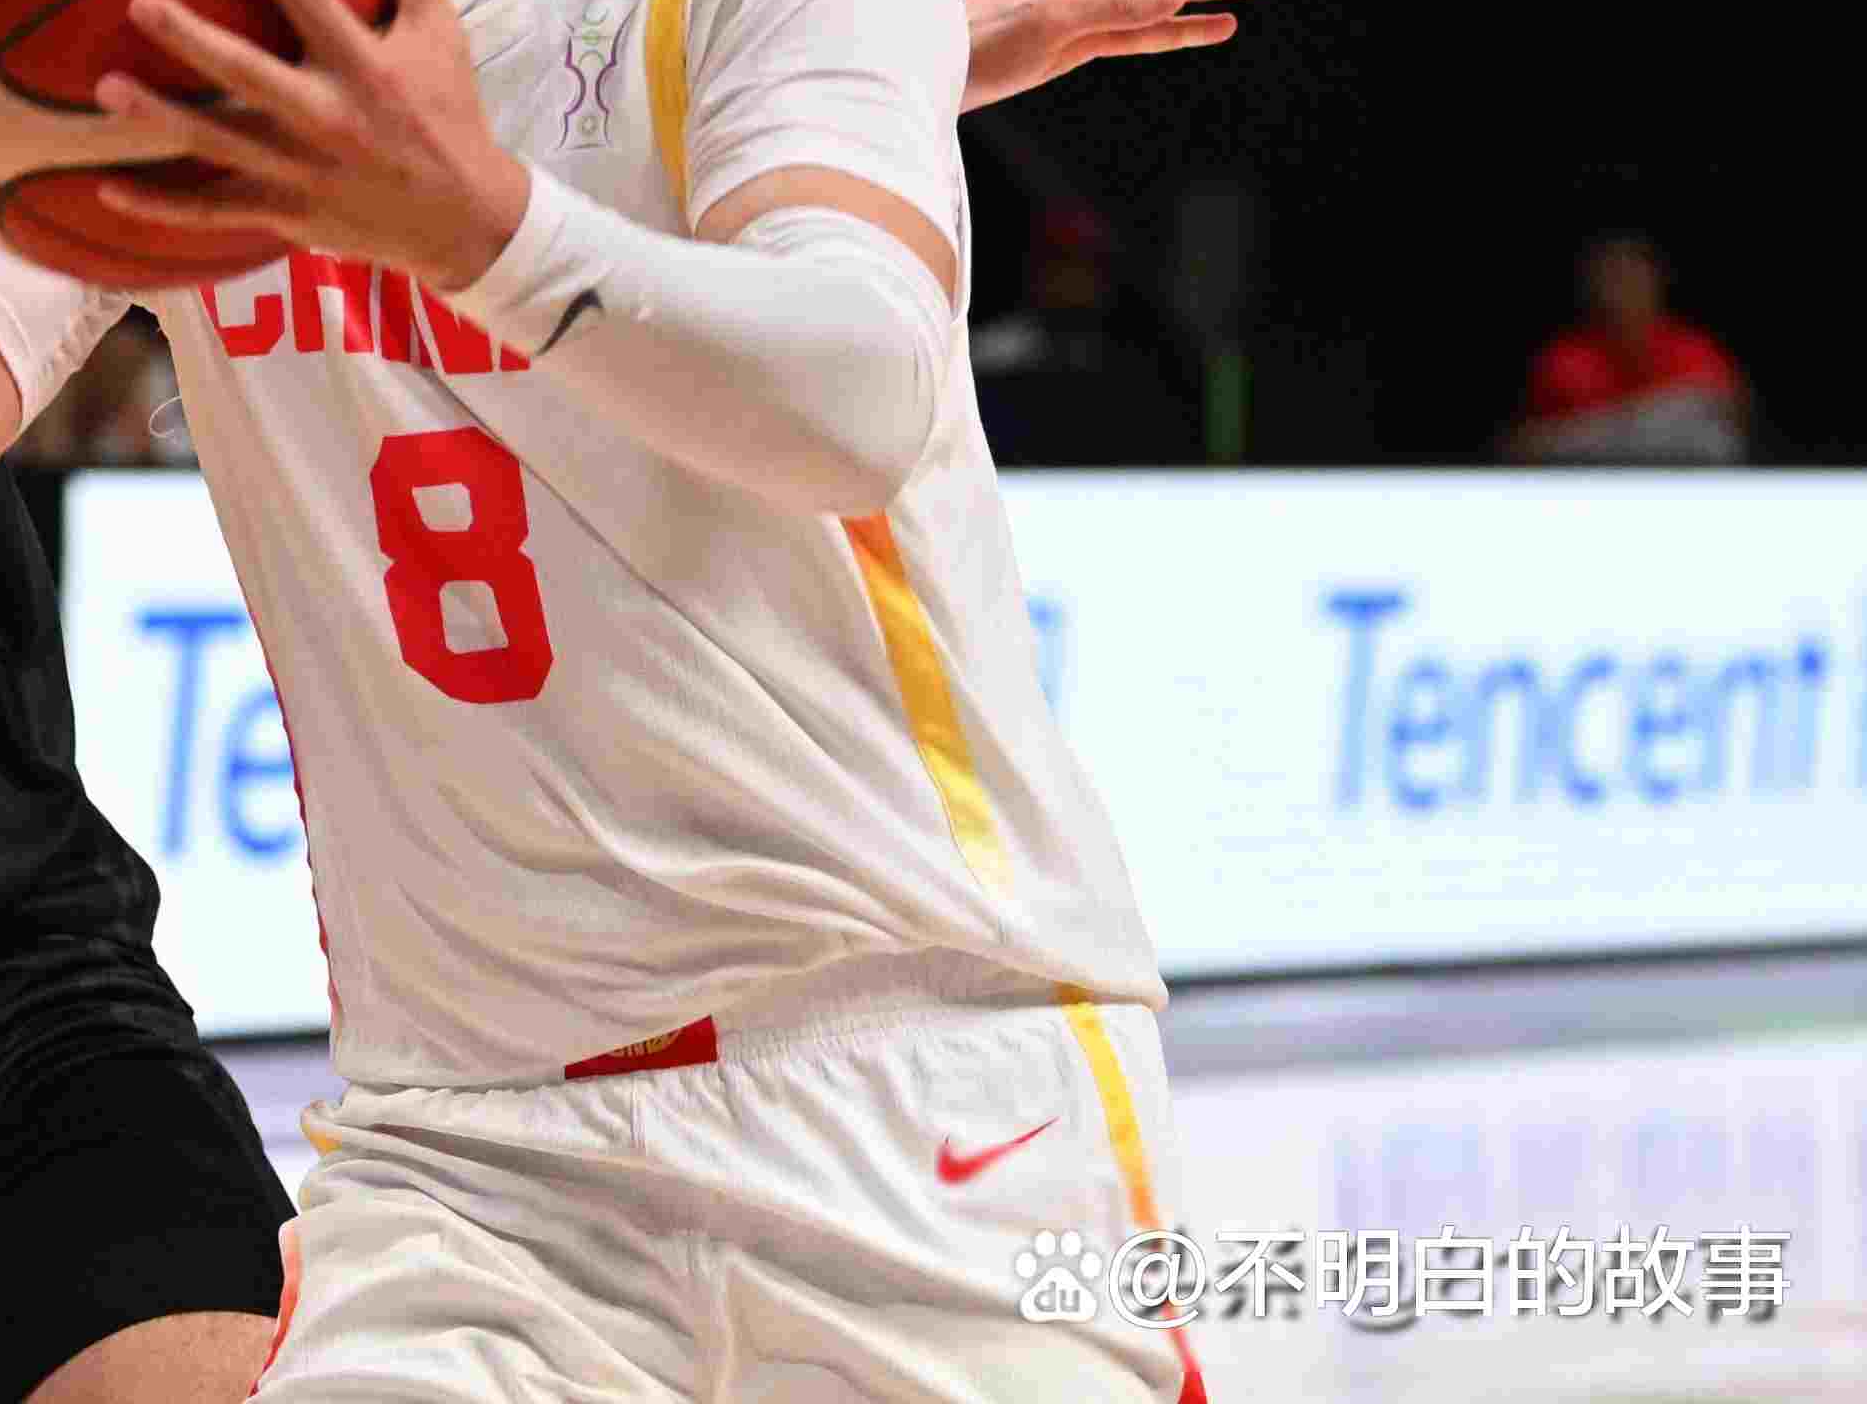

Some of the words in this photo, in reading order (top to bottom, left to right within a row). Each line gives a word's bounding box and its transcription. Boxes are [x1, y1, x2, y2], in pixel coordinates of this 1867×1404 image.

[197, 246, 532, 376] CHIN
[370, 426, 554, 704] 8
[1324, 589, 1834, 808] Tencent
